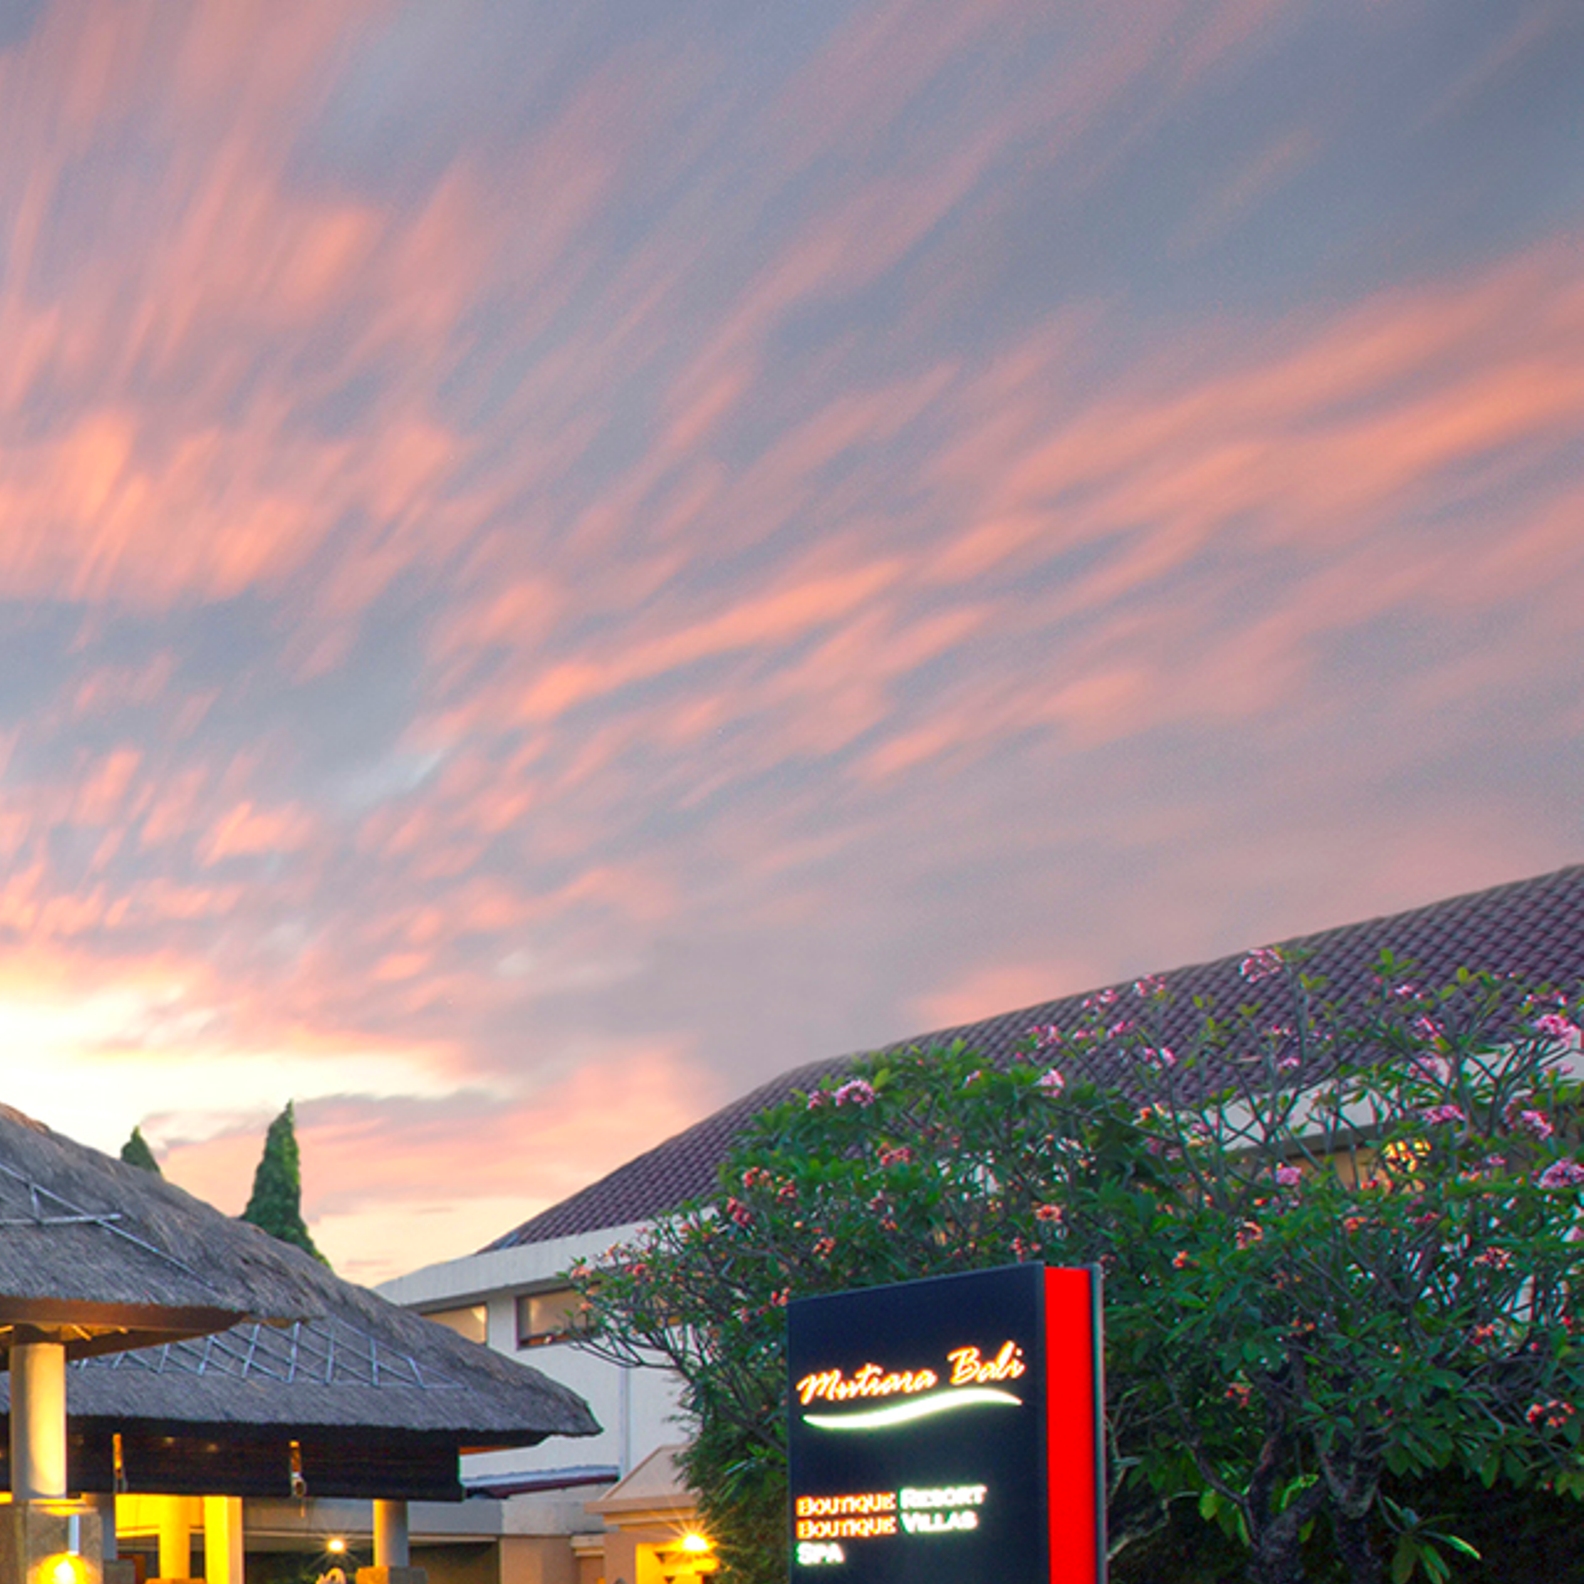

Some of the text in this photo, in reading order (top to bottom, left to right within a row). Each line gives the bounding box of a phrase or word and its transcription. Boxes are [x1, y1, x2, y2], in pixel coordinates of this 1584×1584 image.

[796, 1339, 1026, 1405] Mutiara Bali
[795, 1484, 988, 1517] BOUTIQUE RESORT
[795, 1510, 979, 1540] BOUTIQUE VILLAS
[795, 1541, 846, 1566] SPA
